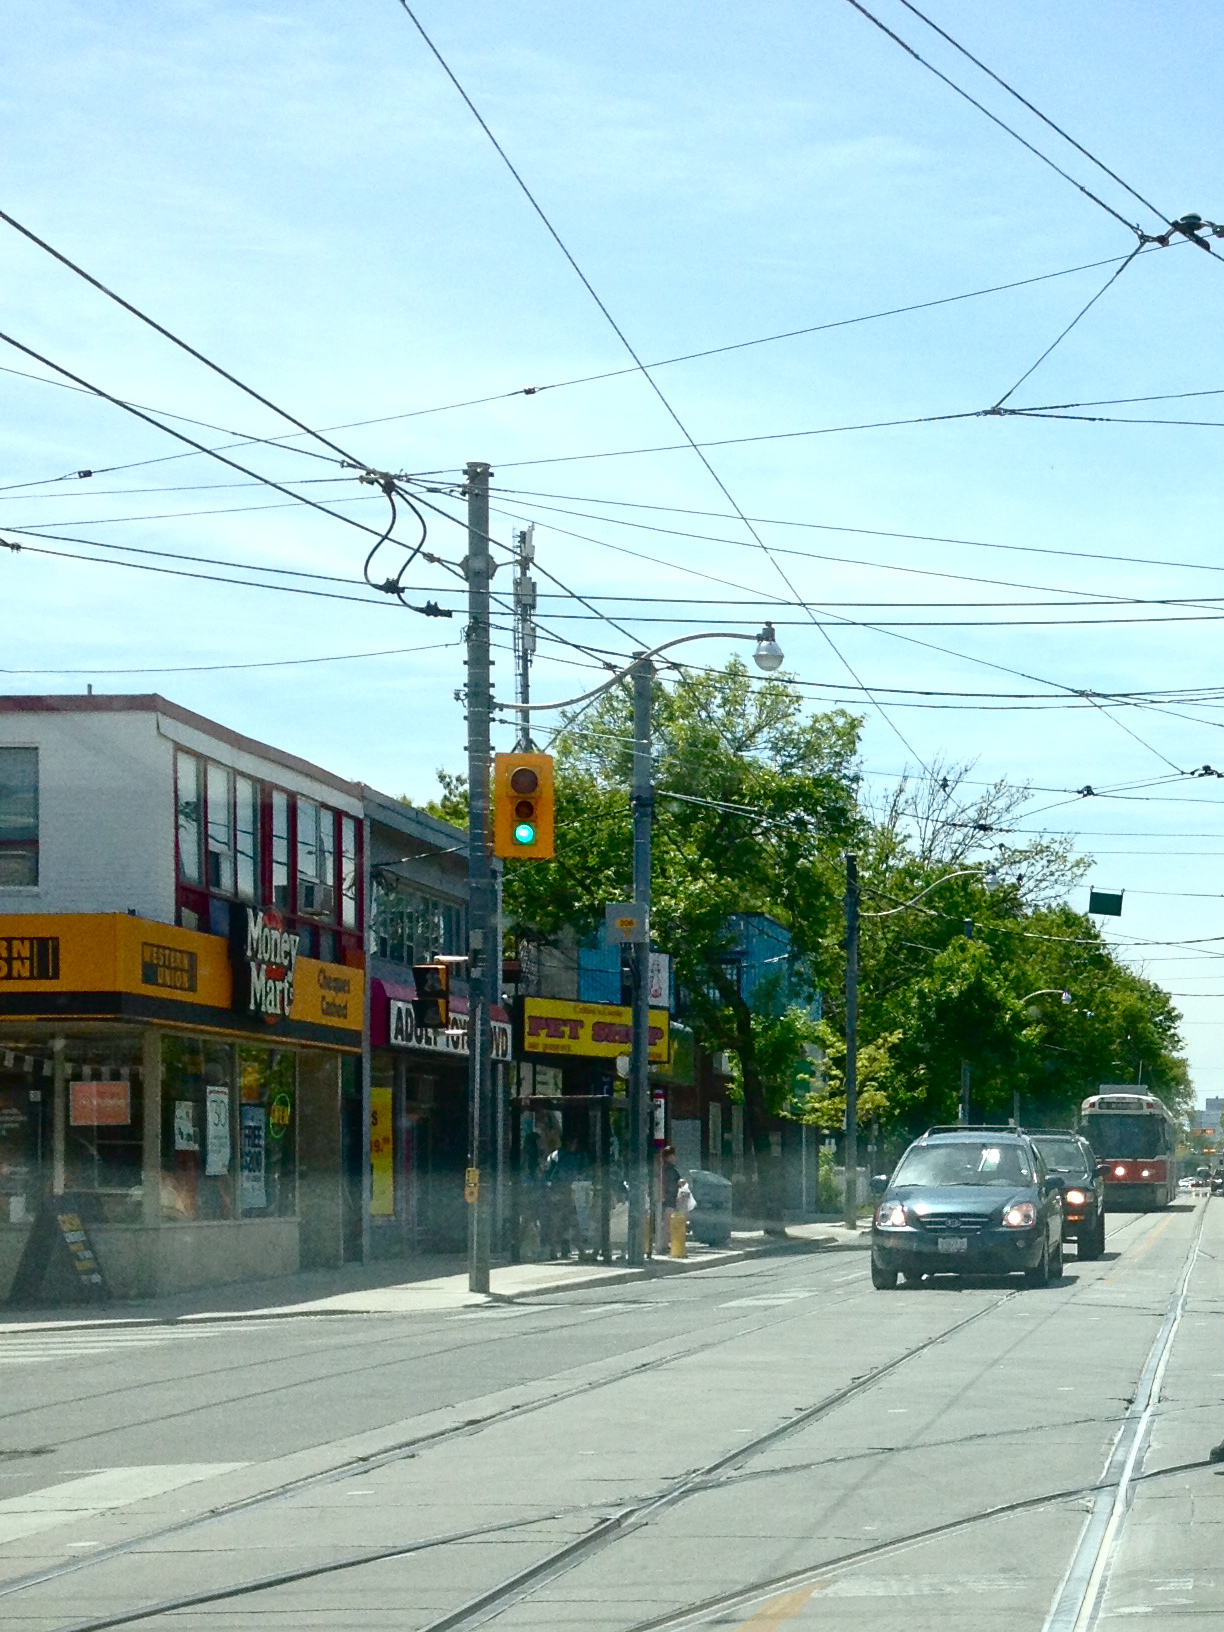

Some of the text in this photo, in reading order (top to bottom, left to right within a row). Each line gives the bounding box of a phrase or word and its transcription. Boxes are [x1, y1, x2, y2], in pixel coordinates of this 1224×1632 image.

[247, 908, 300, 975] Money
[143, 946, 189, 970] WESTERN
[158, 967, 189, 988] UNION
[249, 961, 291, 1016] Mart
[527, 1016, 585, 1041] PET
[591, 1021, 665, 1047] SHP
